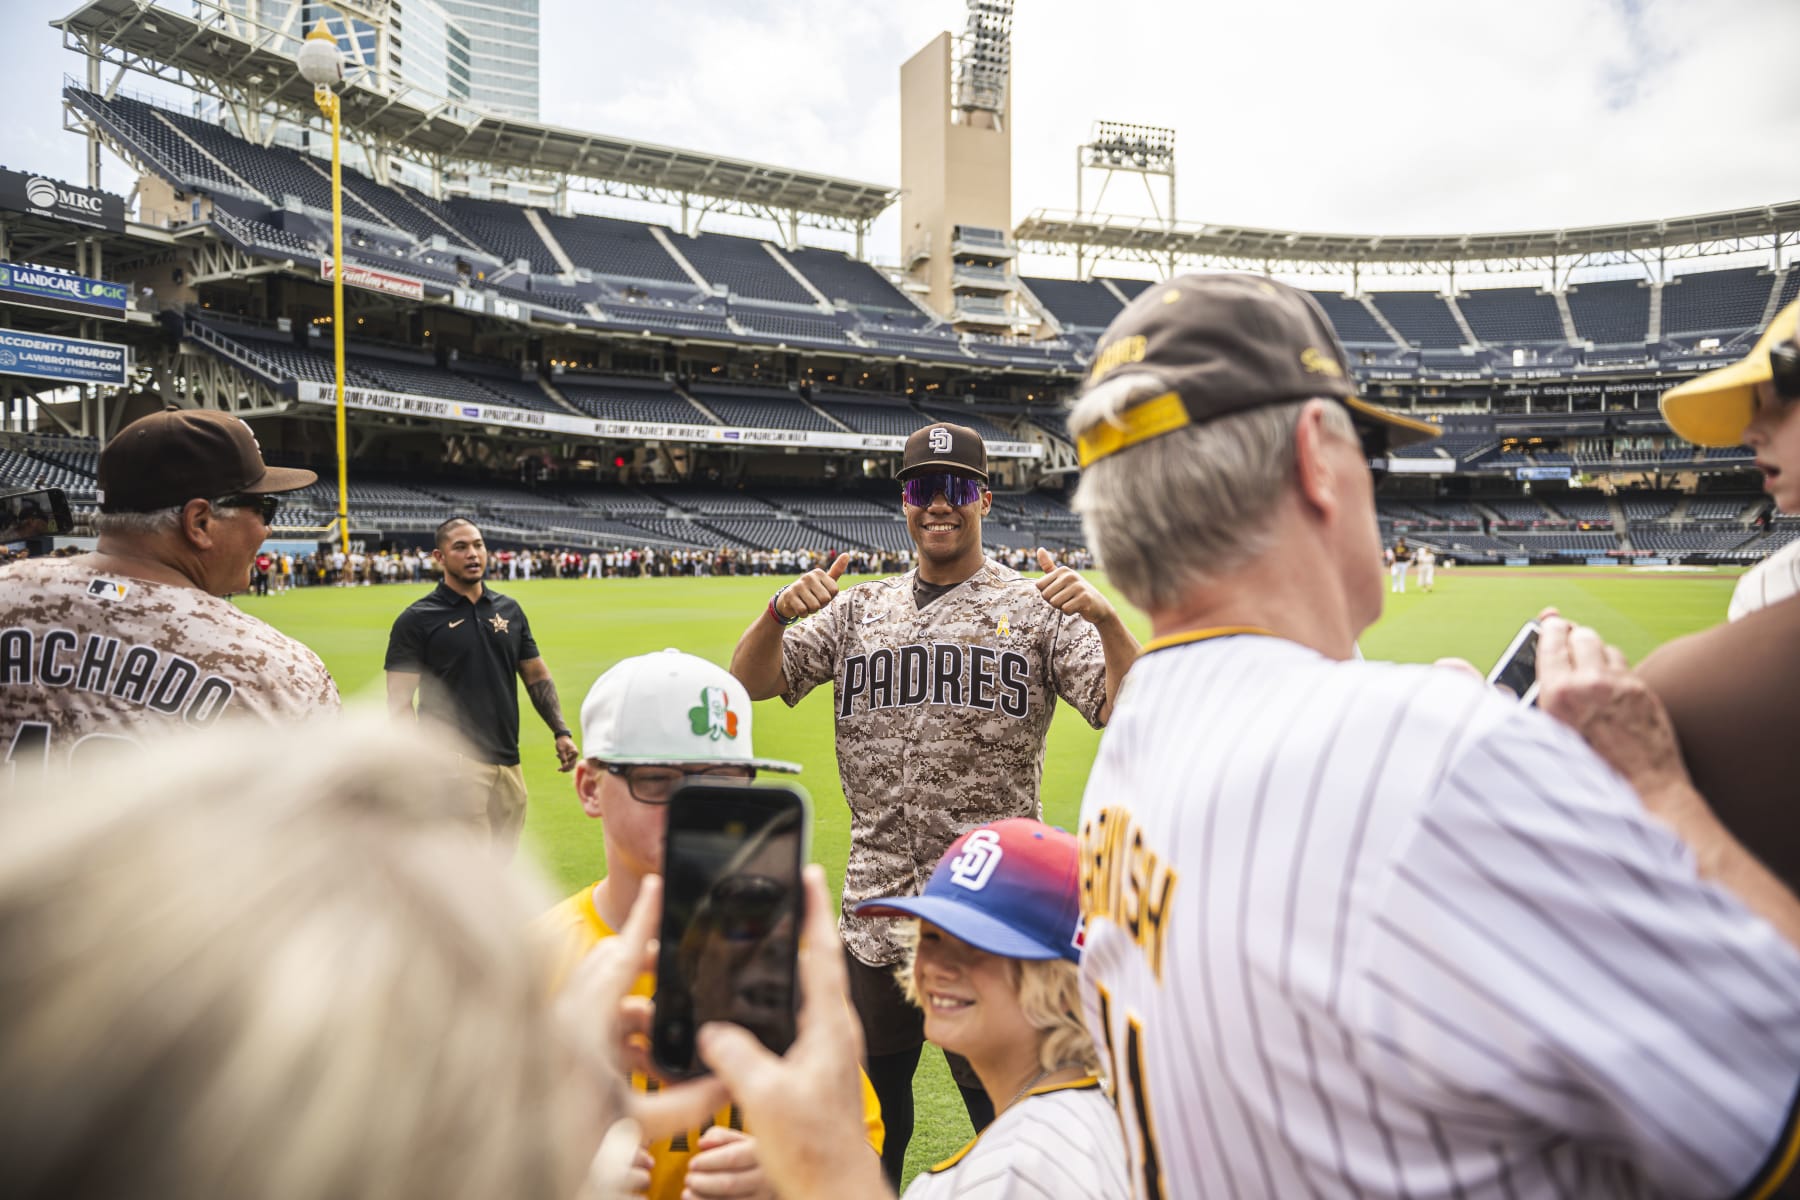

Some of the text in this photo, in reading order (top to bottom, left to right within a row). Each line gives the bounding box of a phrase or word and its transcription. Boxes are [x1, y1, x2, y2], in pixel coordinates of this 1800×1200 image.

[58, 189, 103, 212] MRC
[13, 270, 81, 294] LANDCARE
[85, 283, 126, 300] LOGIC
[19, 352, 122, 371] LAWBROTHERS.COM
[66, 344, 122, 360] INJURED?
[928, 428, 953, 453] SD
[838, 642, 1030, 719] PADRES
[950, 829, 1004, 892] SD
